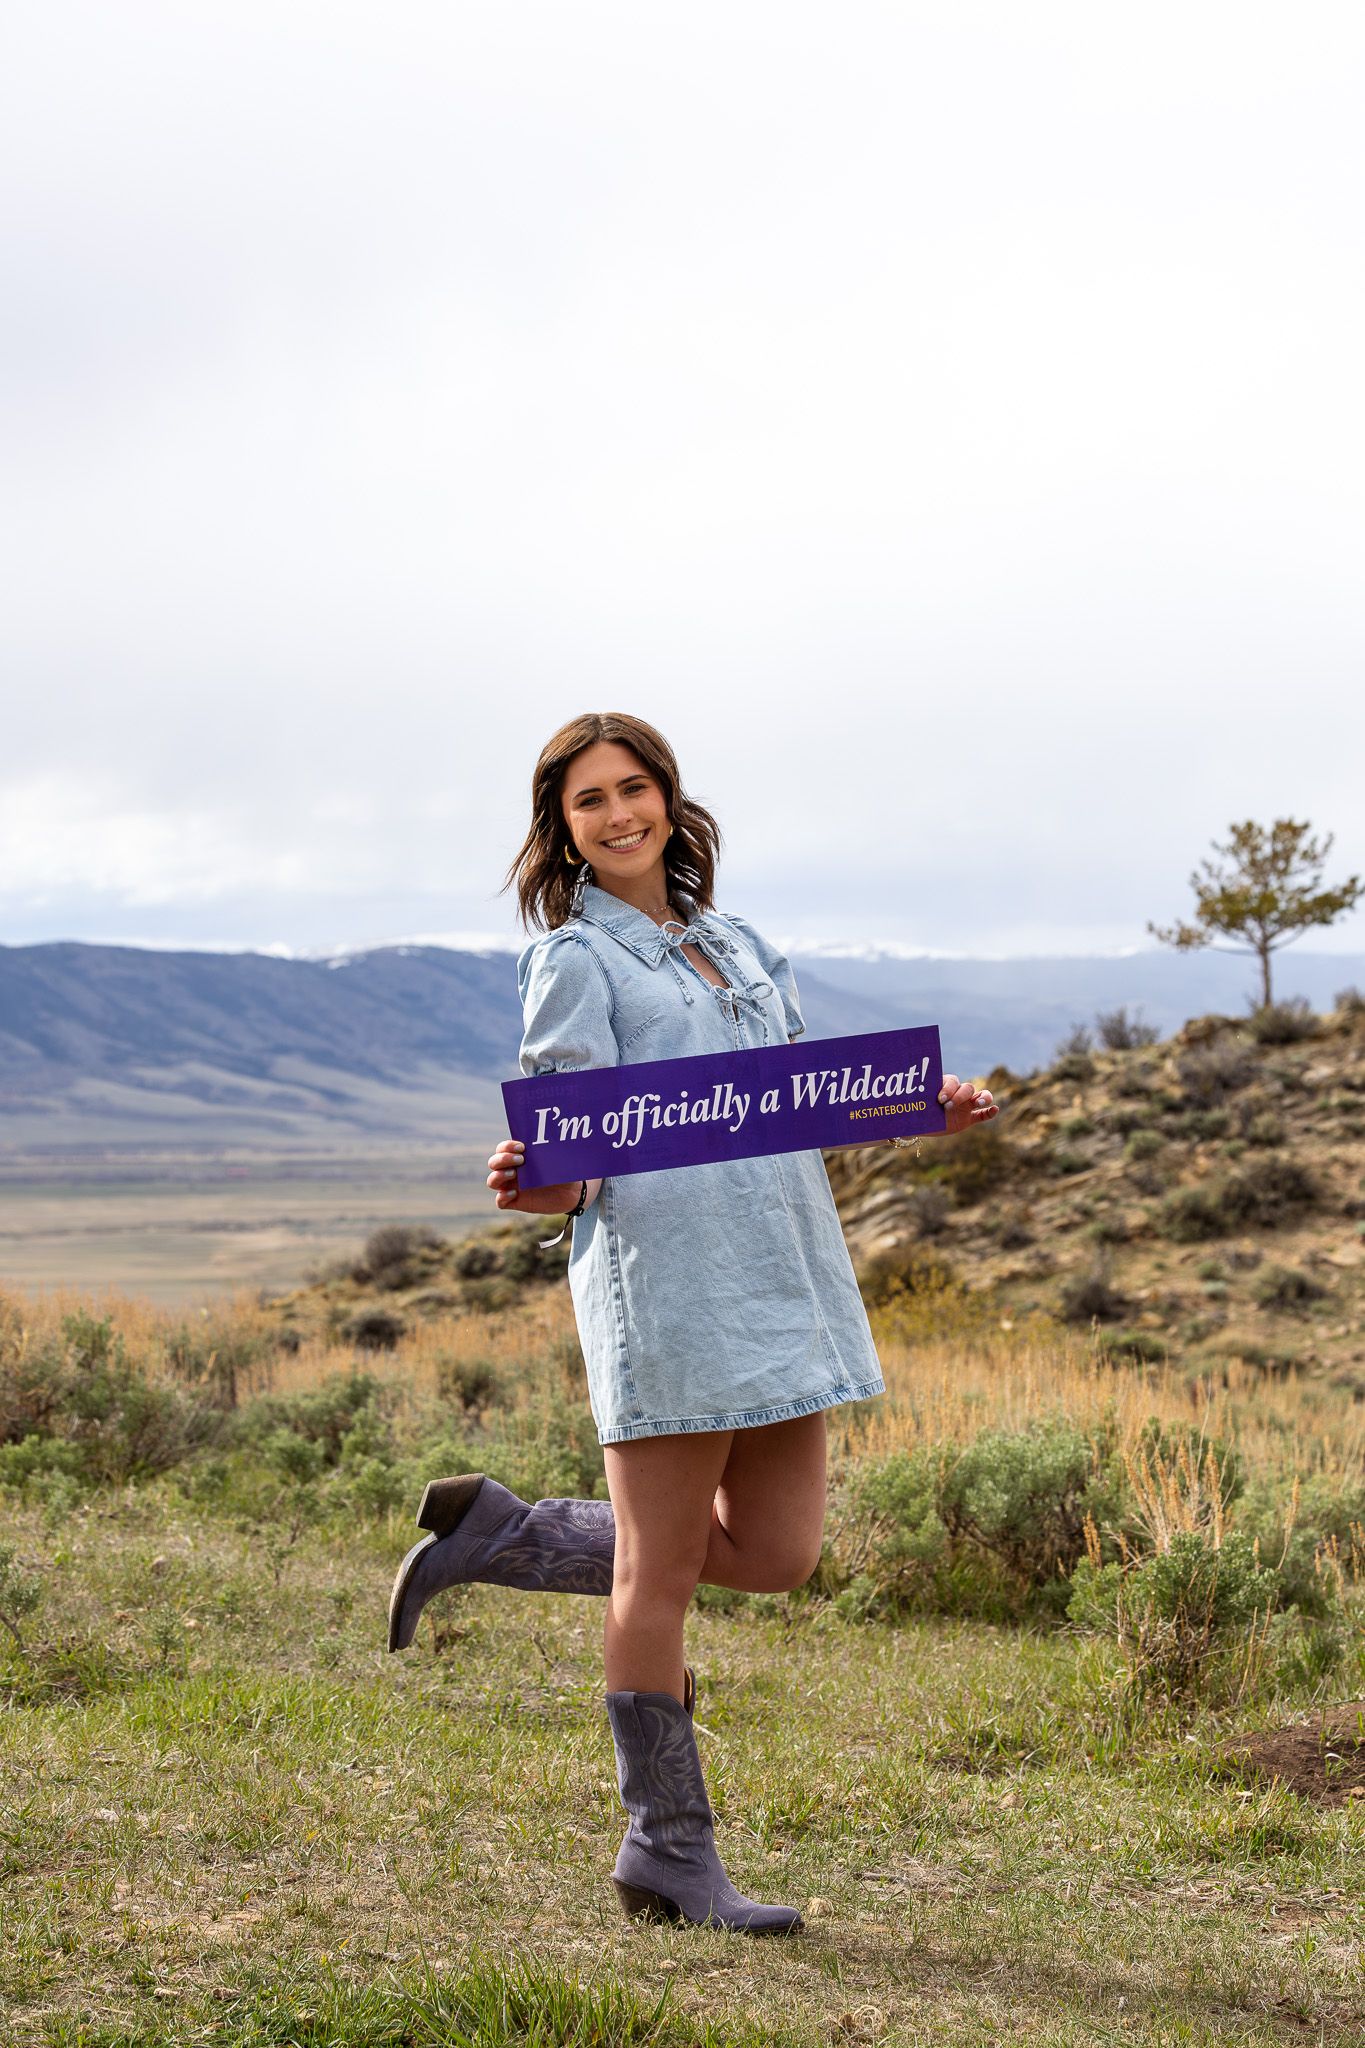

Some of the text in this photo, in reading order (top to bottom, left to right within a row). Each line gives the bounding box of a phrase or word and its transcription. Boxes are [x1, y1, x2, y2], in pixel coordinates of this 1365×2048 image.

[532, 1107, 593, 1145] I’m
[602, 1083, 751, 1148] officially
[759, 1088, 781, 1114] a
[790, 1057, 930, 1110] Wildcat!
[849, 1101, 927, 1121] #KSTATEBOUND
